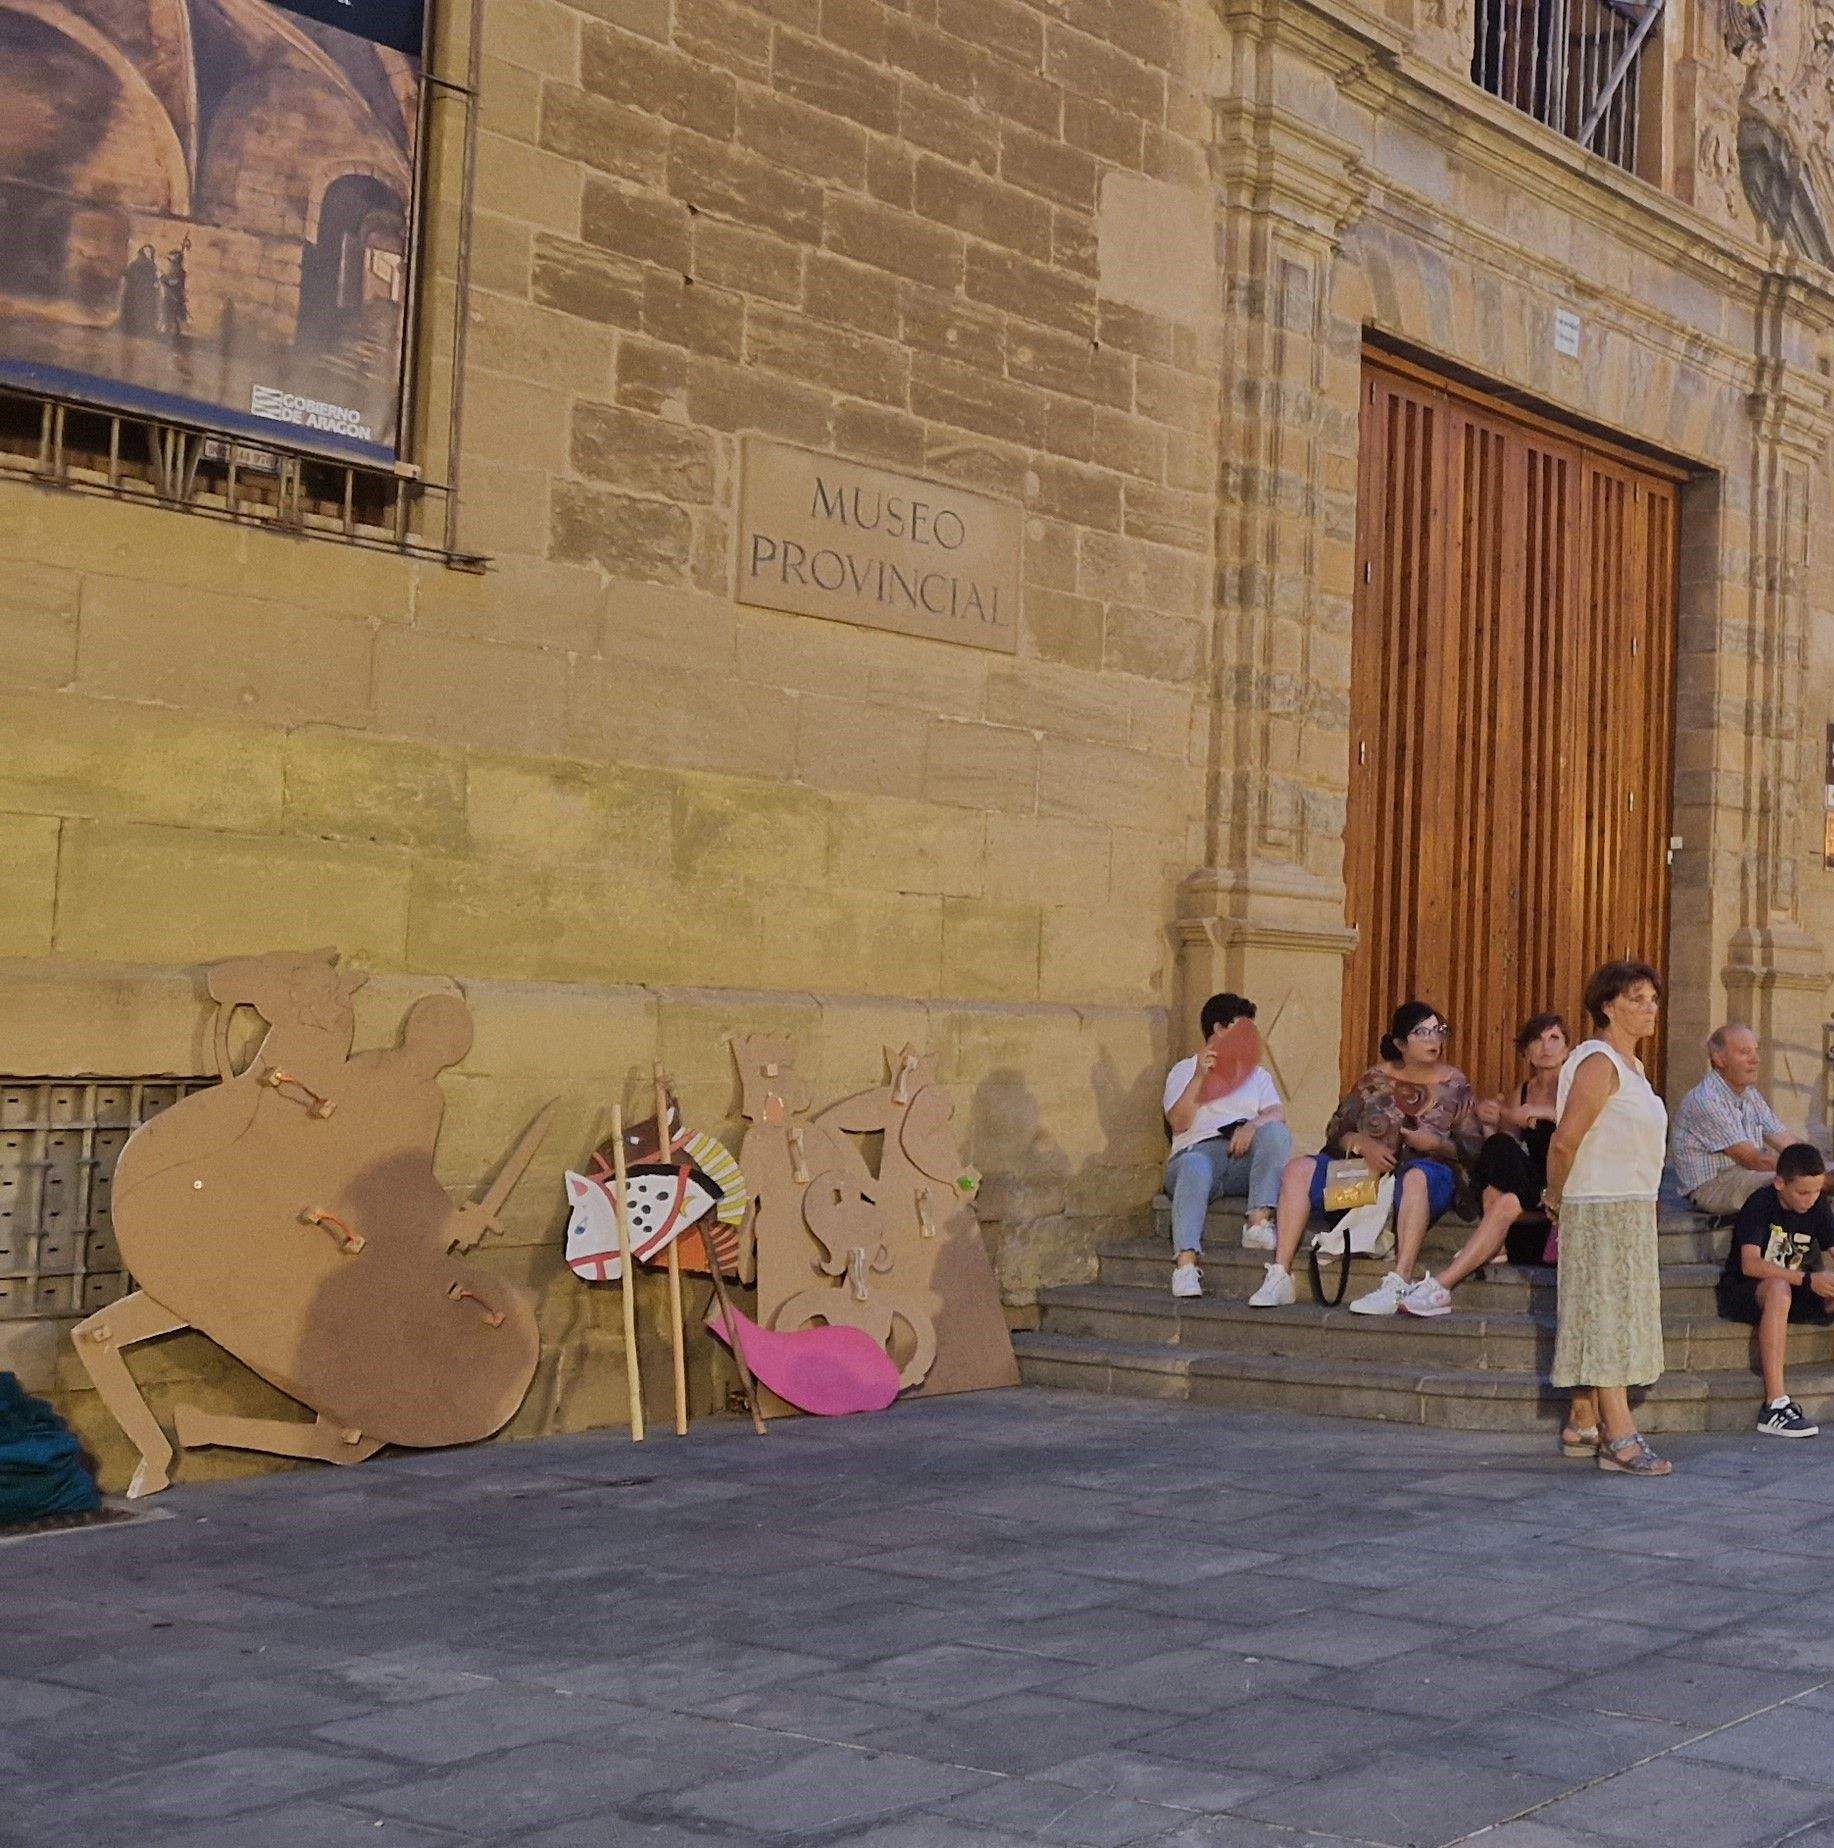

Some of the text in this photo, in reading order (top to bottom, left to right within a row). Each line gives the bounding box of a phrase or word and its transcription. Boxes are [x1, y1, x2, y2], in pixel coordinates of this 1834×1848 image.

[280, 408, 304, 425] DE
[281, 393, 361, 425] GOBIERNO
[810, 476, 967, 551] MUSEO
[749, 534, 1010, 628] PROVINCIAL
